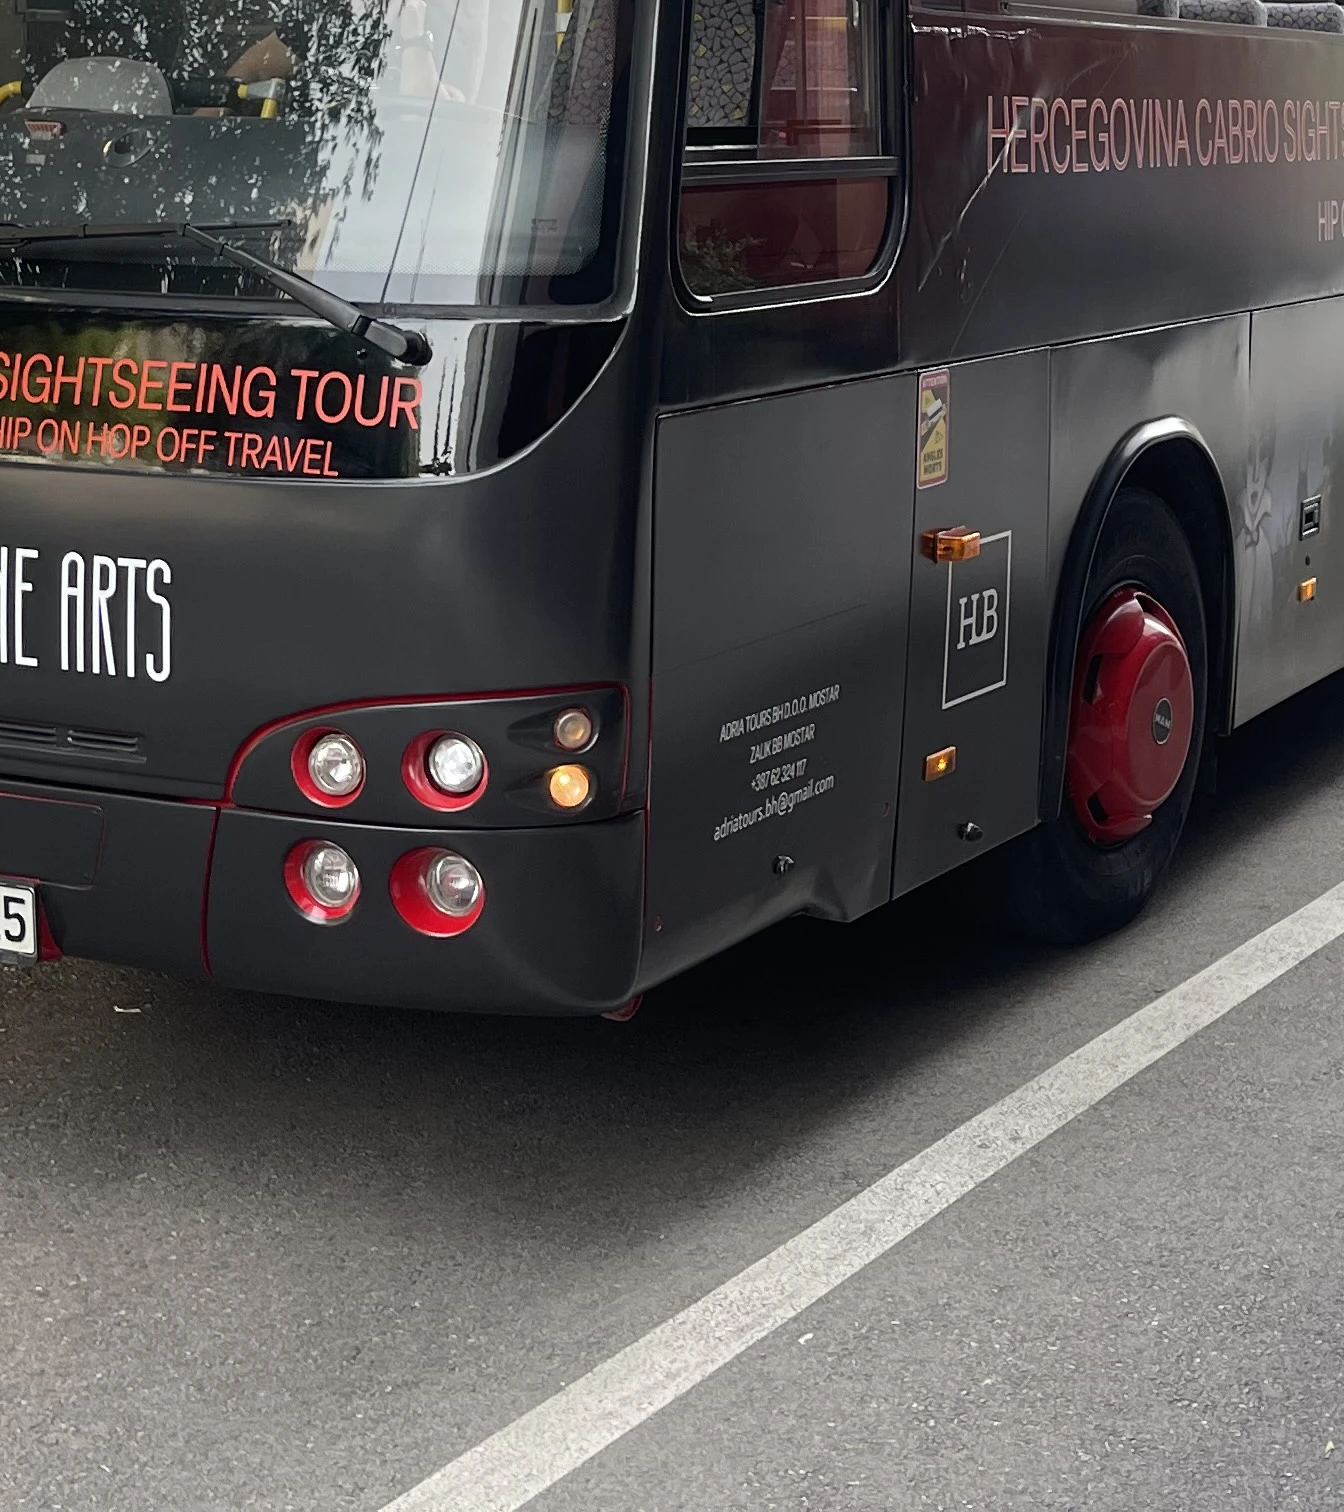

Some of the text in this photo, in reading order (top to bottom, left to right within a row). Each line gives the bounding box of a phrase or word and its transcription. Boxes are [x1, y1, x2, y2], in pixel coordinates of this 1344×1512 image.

[987, 94, 1191, 174] HERCEGOVINA
[1195, 98, 1279, 166] CABRIO
[1318, 199, 1340, 242] HIP
[290, 368, 423, 430] TOUR
[36, 417, 81, 455] ON
[87, 421, 152, 461] HOP
[156, 428, 219, 465] OFF
[223, 432, 339, 477] TRAVEL
[59, 550, 172, 684] ARTS
[719, 719, 745, 742] ADRIA
[745, 707, 772, 733] TOURS
[772, 703, 783, 723] BH
[808, 684, 840, 710] MOSTAR
[1154, 713, 1171, 729] MAN
[749, 740, 772, 764] ZALIK
[783, 723, 816, 750] MOSTAR
[713, 775, 835, 841] adriatours.bh@gmail.com
[751, 770, 770, 791] +387
